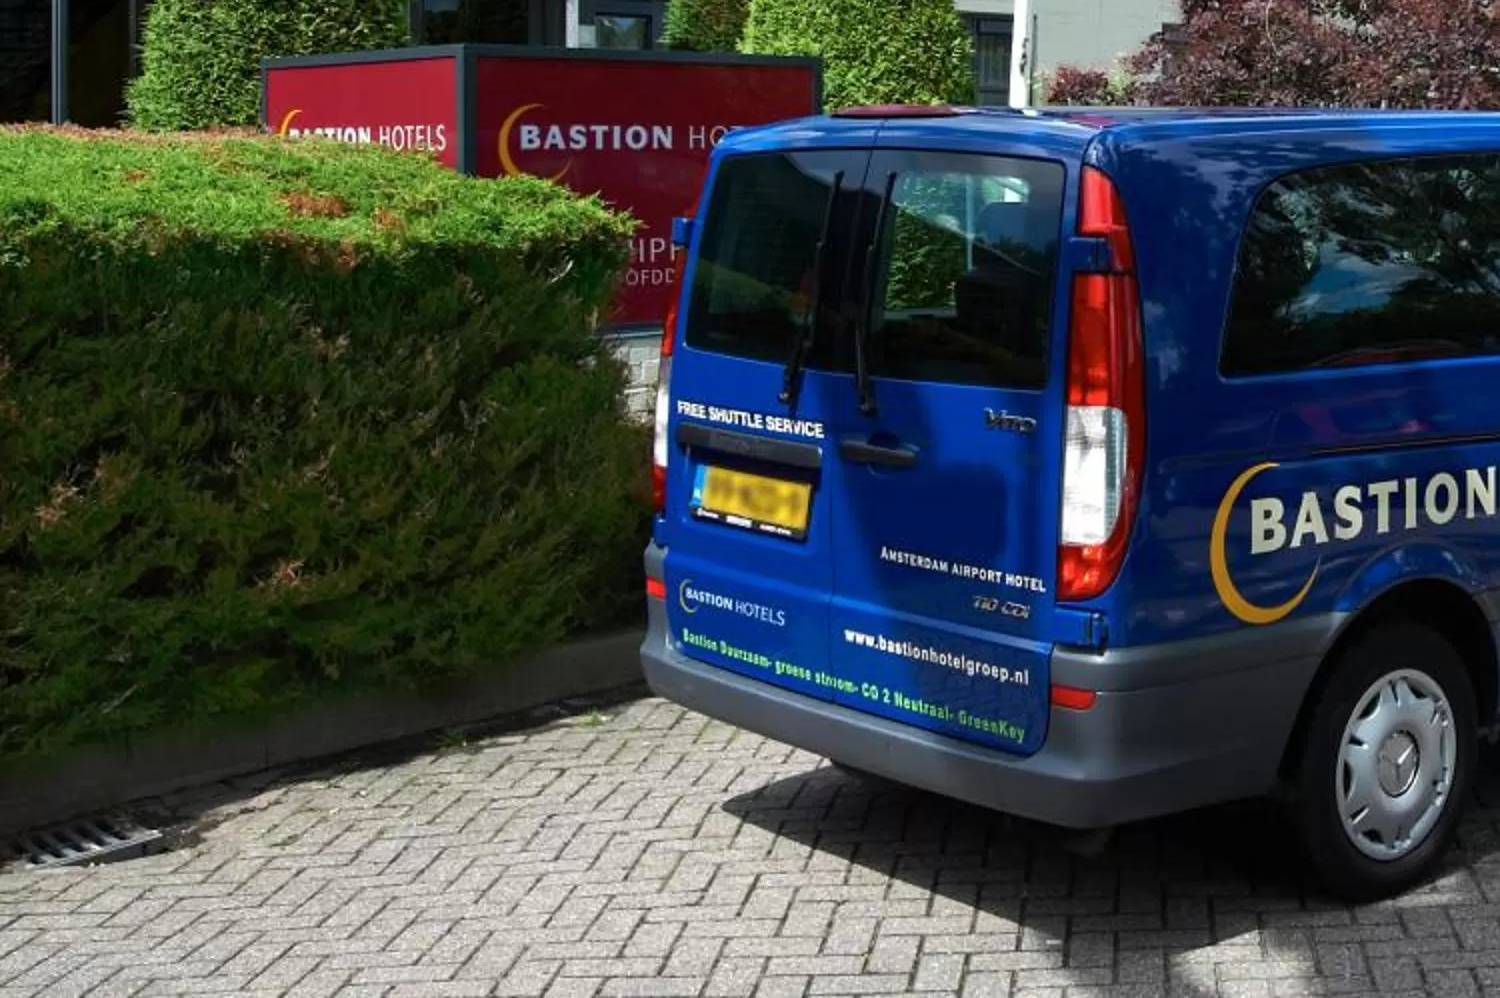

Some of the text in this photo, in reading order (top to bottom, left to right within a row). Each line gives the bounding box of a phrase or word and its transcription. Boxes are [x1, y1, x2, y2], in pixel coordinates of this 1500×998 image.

[379, 124, 447, 151] HOTELS
[519, 125, 673, 150] BASTION
[677, 400, 824, 439] FREE SHUTTLE SERVICE
[1249, 466, 1497, 555] BASTION
[880, 546, 1047, 593] AMSTERDAM AIRPORT HOTEL
[685, 587, 785, 627] BASTION HOTELS
[844, 629, 1029, 686] www.bastionhotelgroep.nl
[882, 688, 891, 704] 2
